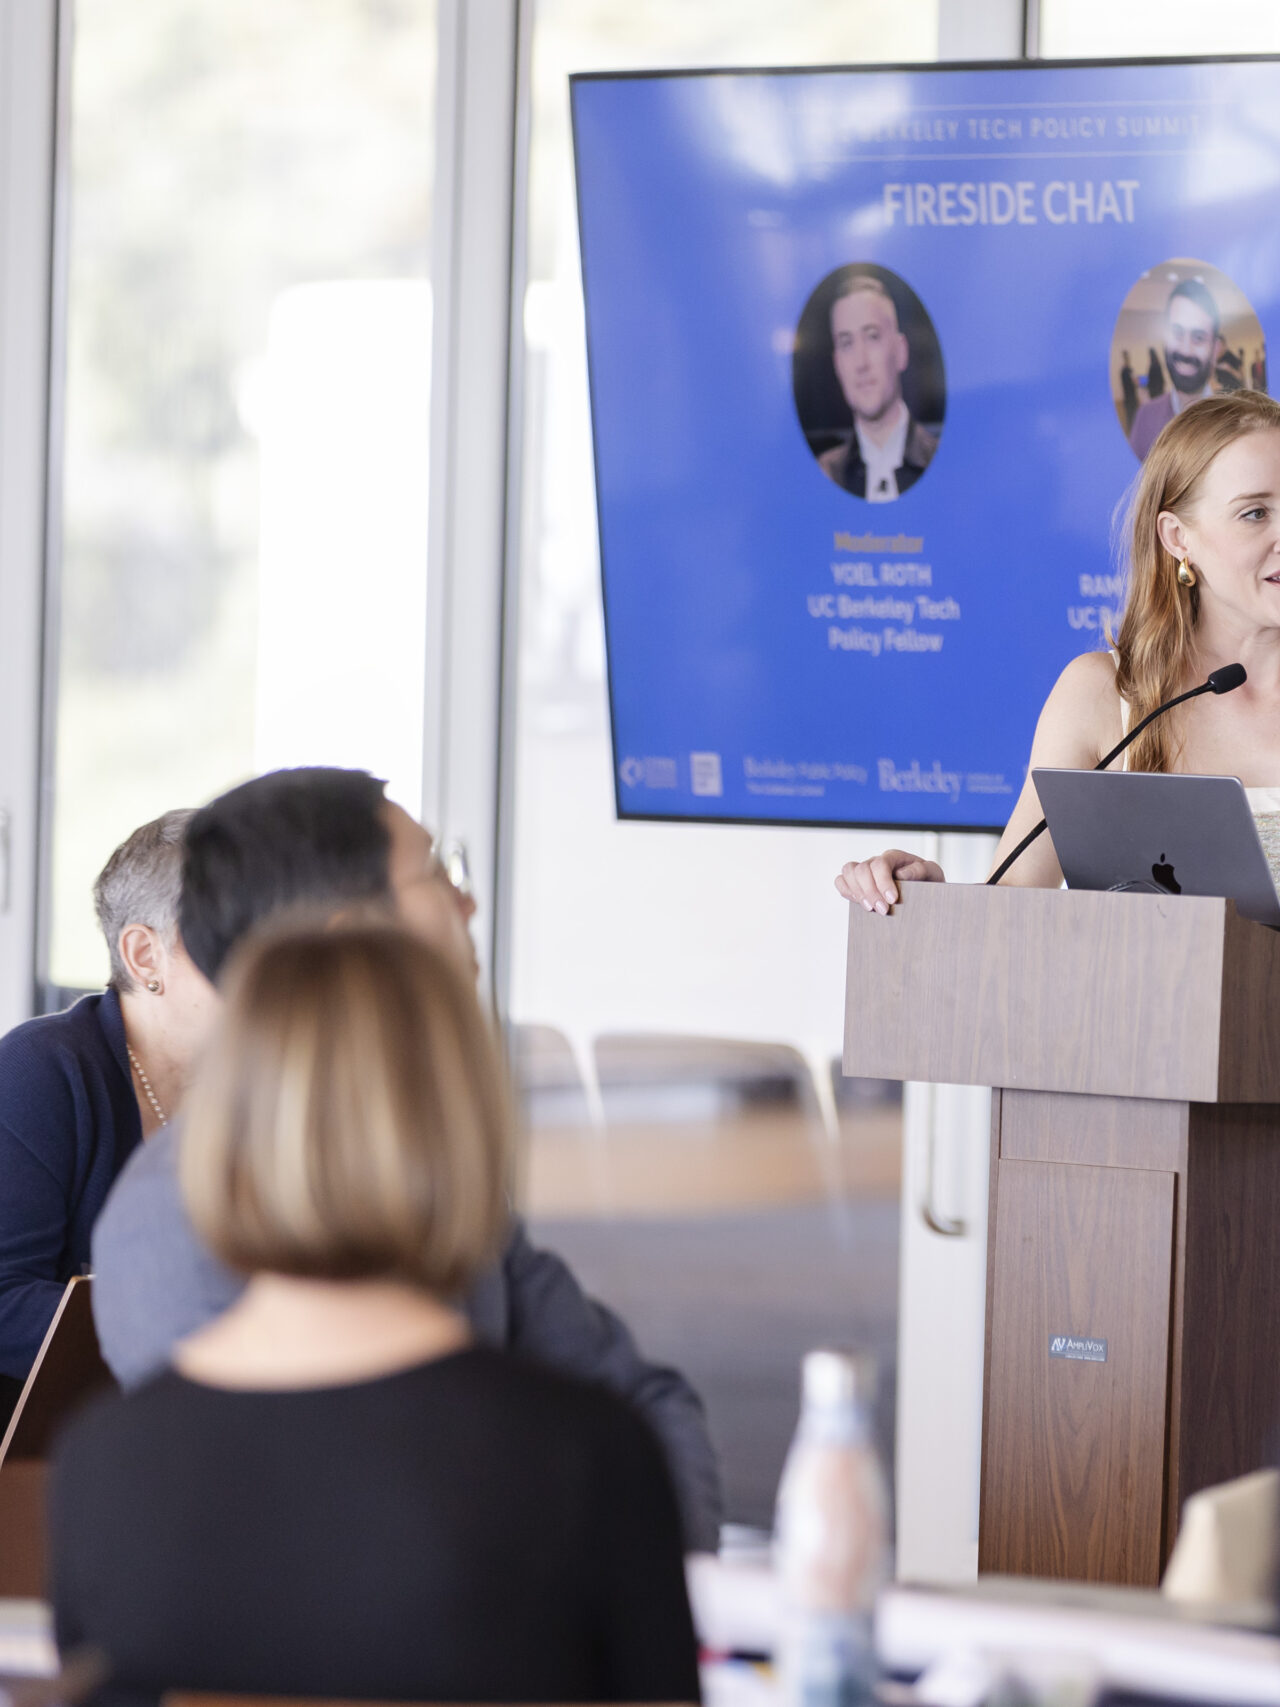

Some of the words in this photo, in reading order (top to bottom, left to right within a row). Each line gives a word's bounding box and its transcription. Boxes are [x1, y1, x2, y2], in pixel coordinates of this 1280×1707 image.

[968, 118, 1022, 140] TECH
[1029, 116, 1106, 139] POLICY
[1116, 114, 1200, 138] SUMMIT
[882, 182, 1037, 227] FIRESIDE
[1042, 180, 1140, 225] CHAT
[879, 562, 933, 587] ROTH
[806, 594, 836, 619] UC
[836, 594, 916, 626] Berkeley
[915, 595, 961, 621] Tech
[1066, 605, 1098, 631] UC
[827, 626, 882, 657] Policy
[882, 627, 944, 653] Fellow
[877, 757, 961, 804] Berkeley
